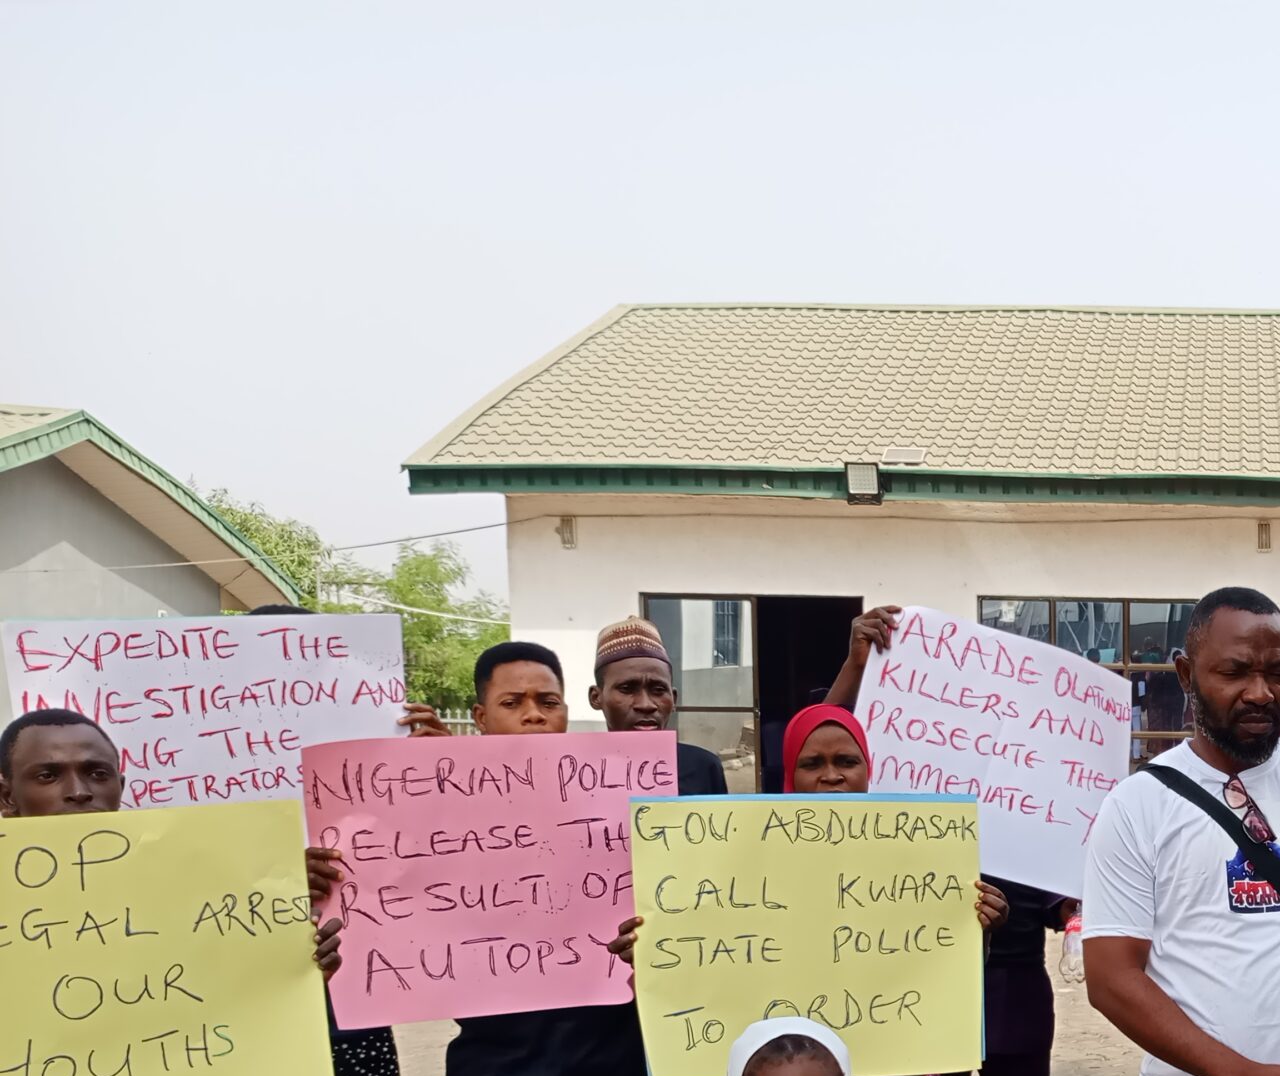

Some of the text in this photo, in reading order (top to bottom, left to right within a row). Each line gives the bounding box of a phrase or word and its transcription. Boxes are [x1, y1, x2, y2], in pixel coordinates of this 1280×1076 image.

[17, 627, 349, 672] EXPEDITE THE
[352, 677, 405, 704] AND
[878, 659, 1104, 746] KILLERS AND
[198, 727, 301, 758] THE
[866, 700, 1045, 769] PROSECUTE
[310, 755, 673, 810] NIGERIAN POLICE
[320, 818, 630, 874] RELEASE TH
[635, 806, 976, 851] GOV. ABDULRASAK
[0, 830, 130, 891] OP
[340, 871, 633, 929] RESULT OF
[655, 872, 963, 913] CALL KWARA
[366, 933, 617, 996] AUTOPSY
[651, 925, 955, 969] STATE POLICE
[53, 964, 203, 1020] OUR
[664, 989, 922, 1051] TO ORDER
